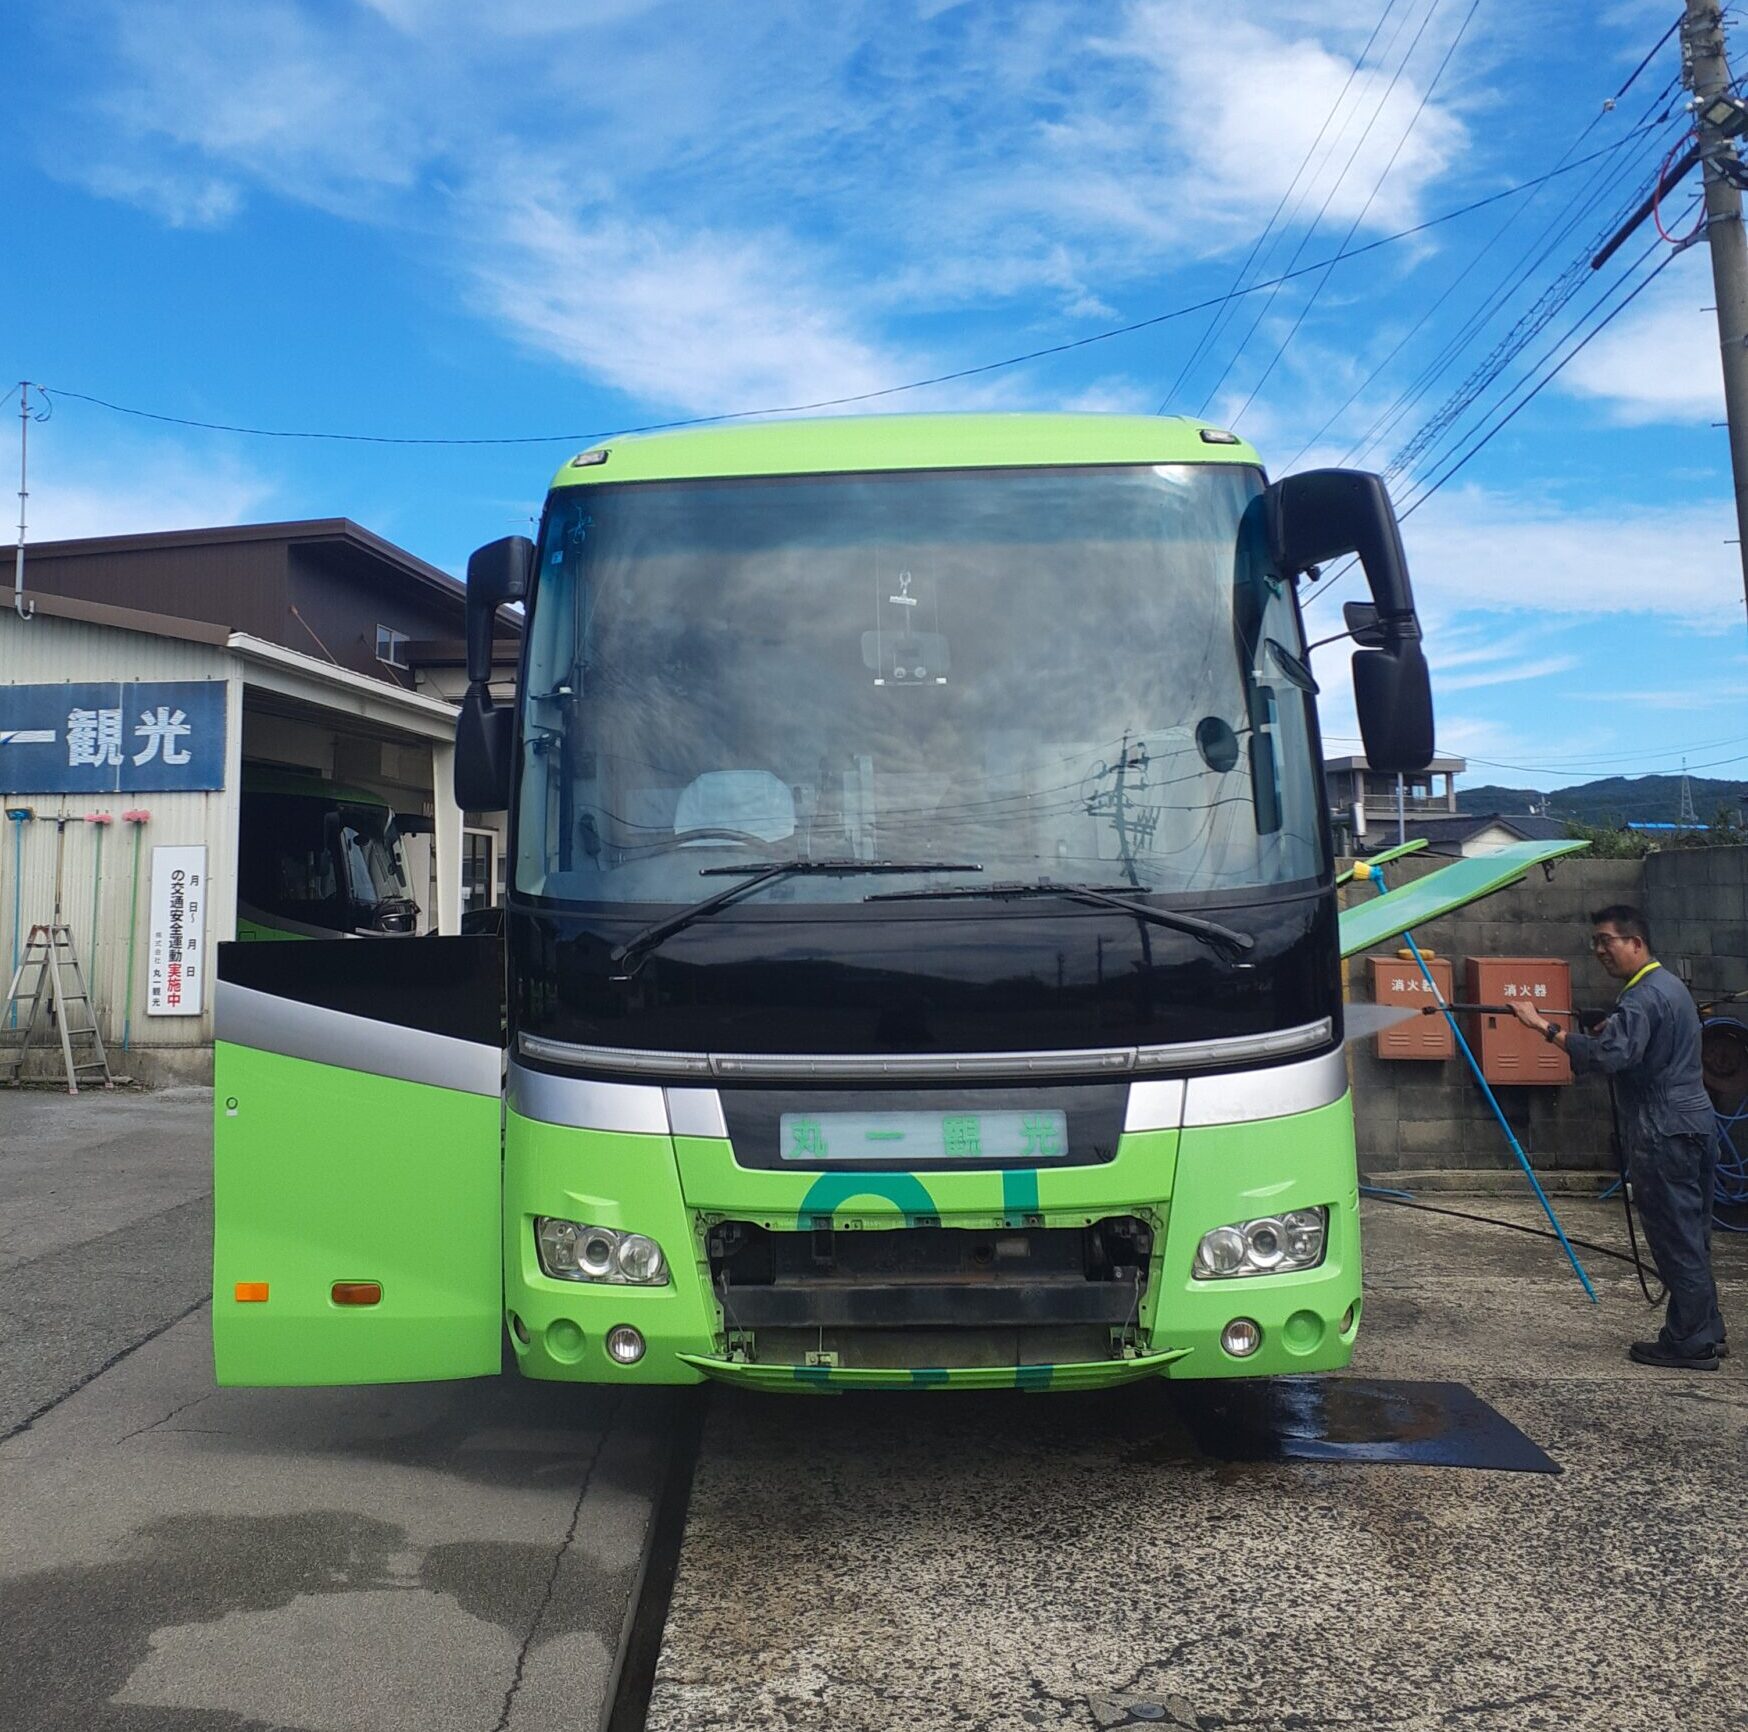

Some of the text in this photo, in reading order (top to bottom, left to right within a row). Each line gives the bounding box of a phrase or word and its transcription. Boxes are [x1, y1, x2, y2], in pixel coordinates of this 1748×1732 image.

[167, 869, 185, 1008] の交通安全運動実施中
[1503, 983, 1548, 998] 消火器
